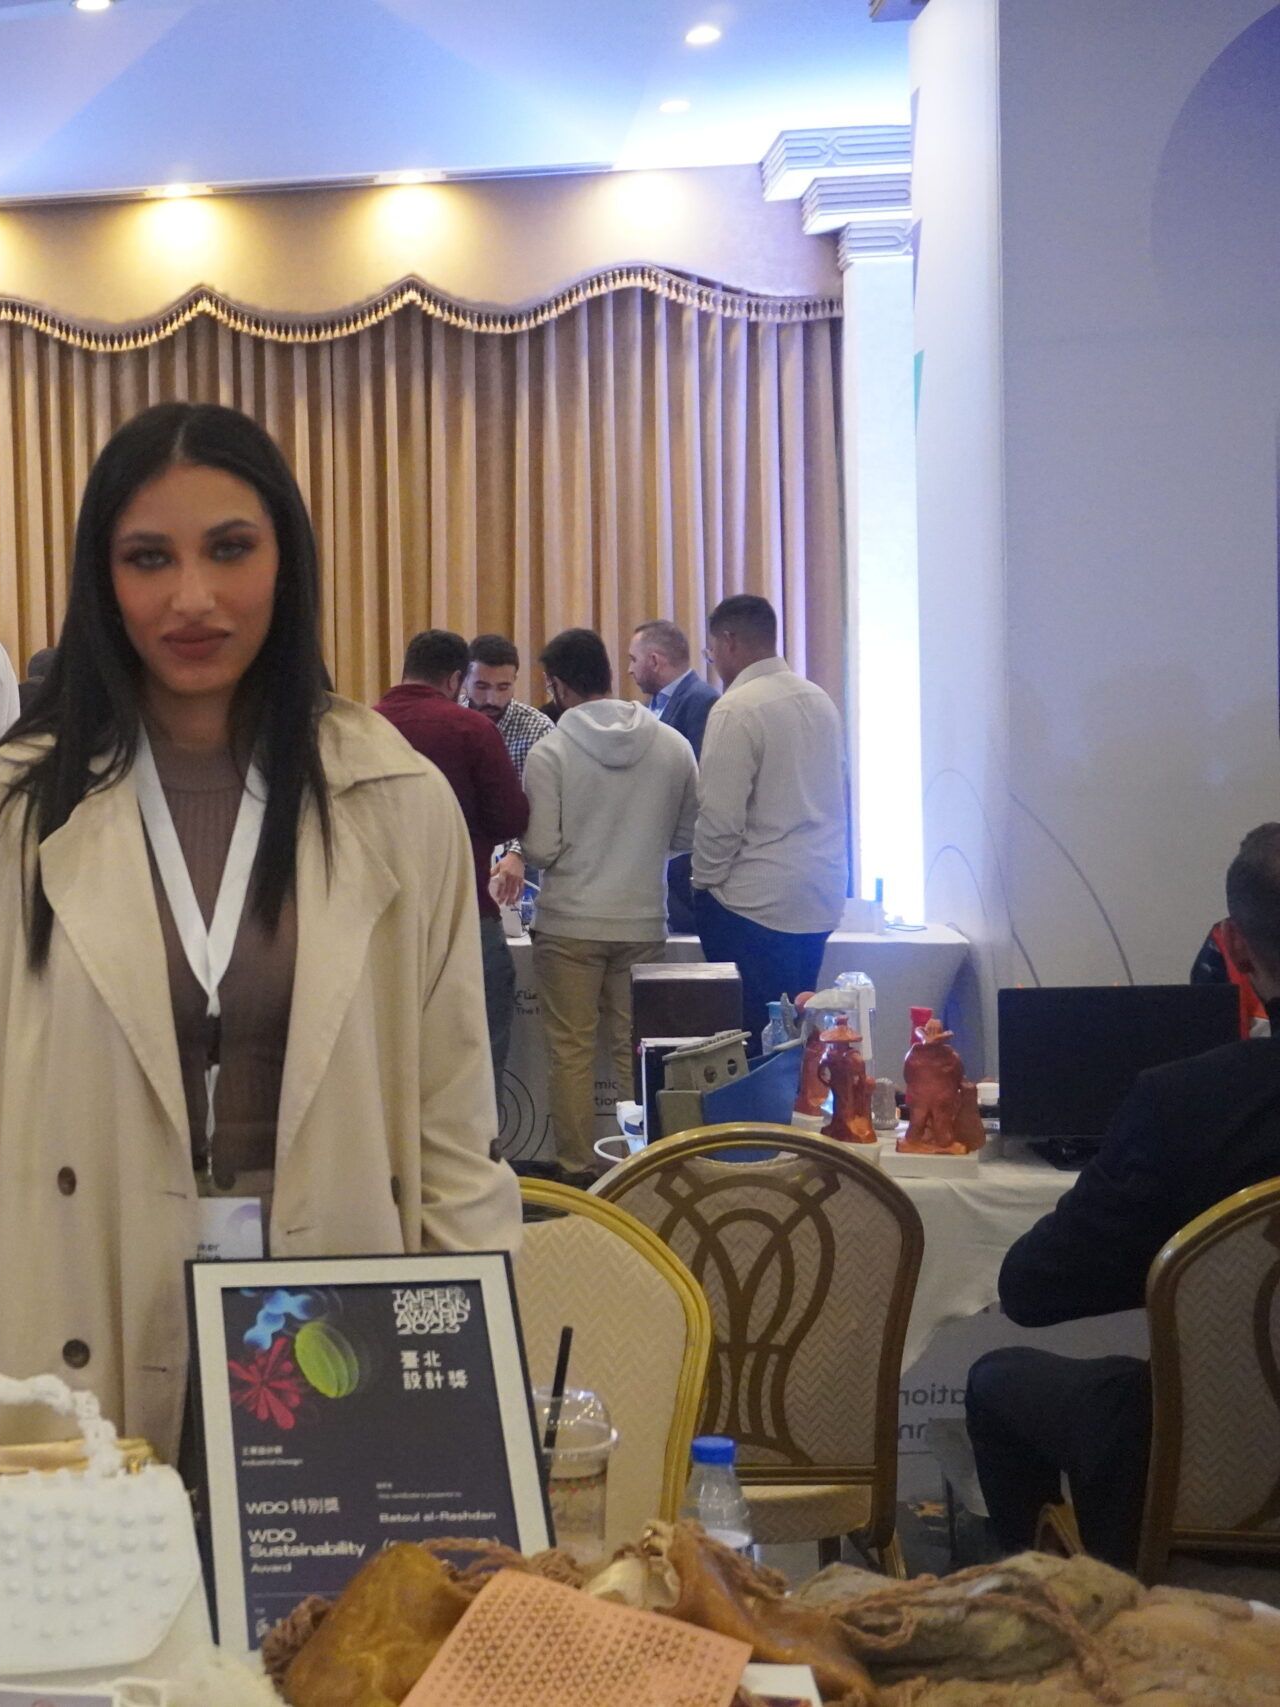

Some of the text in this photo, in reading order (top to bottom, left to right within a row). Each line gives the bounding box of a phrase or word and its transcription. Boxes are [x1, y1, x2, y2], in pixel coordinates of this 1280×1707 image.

[245, 1501, 289, 1515] WDO
[248, 1528, 297, 1543] WDO
[249, 1539, 366, 1558] Sustainability
[251, 1562, 292, 1574] Award
